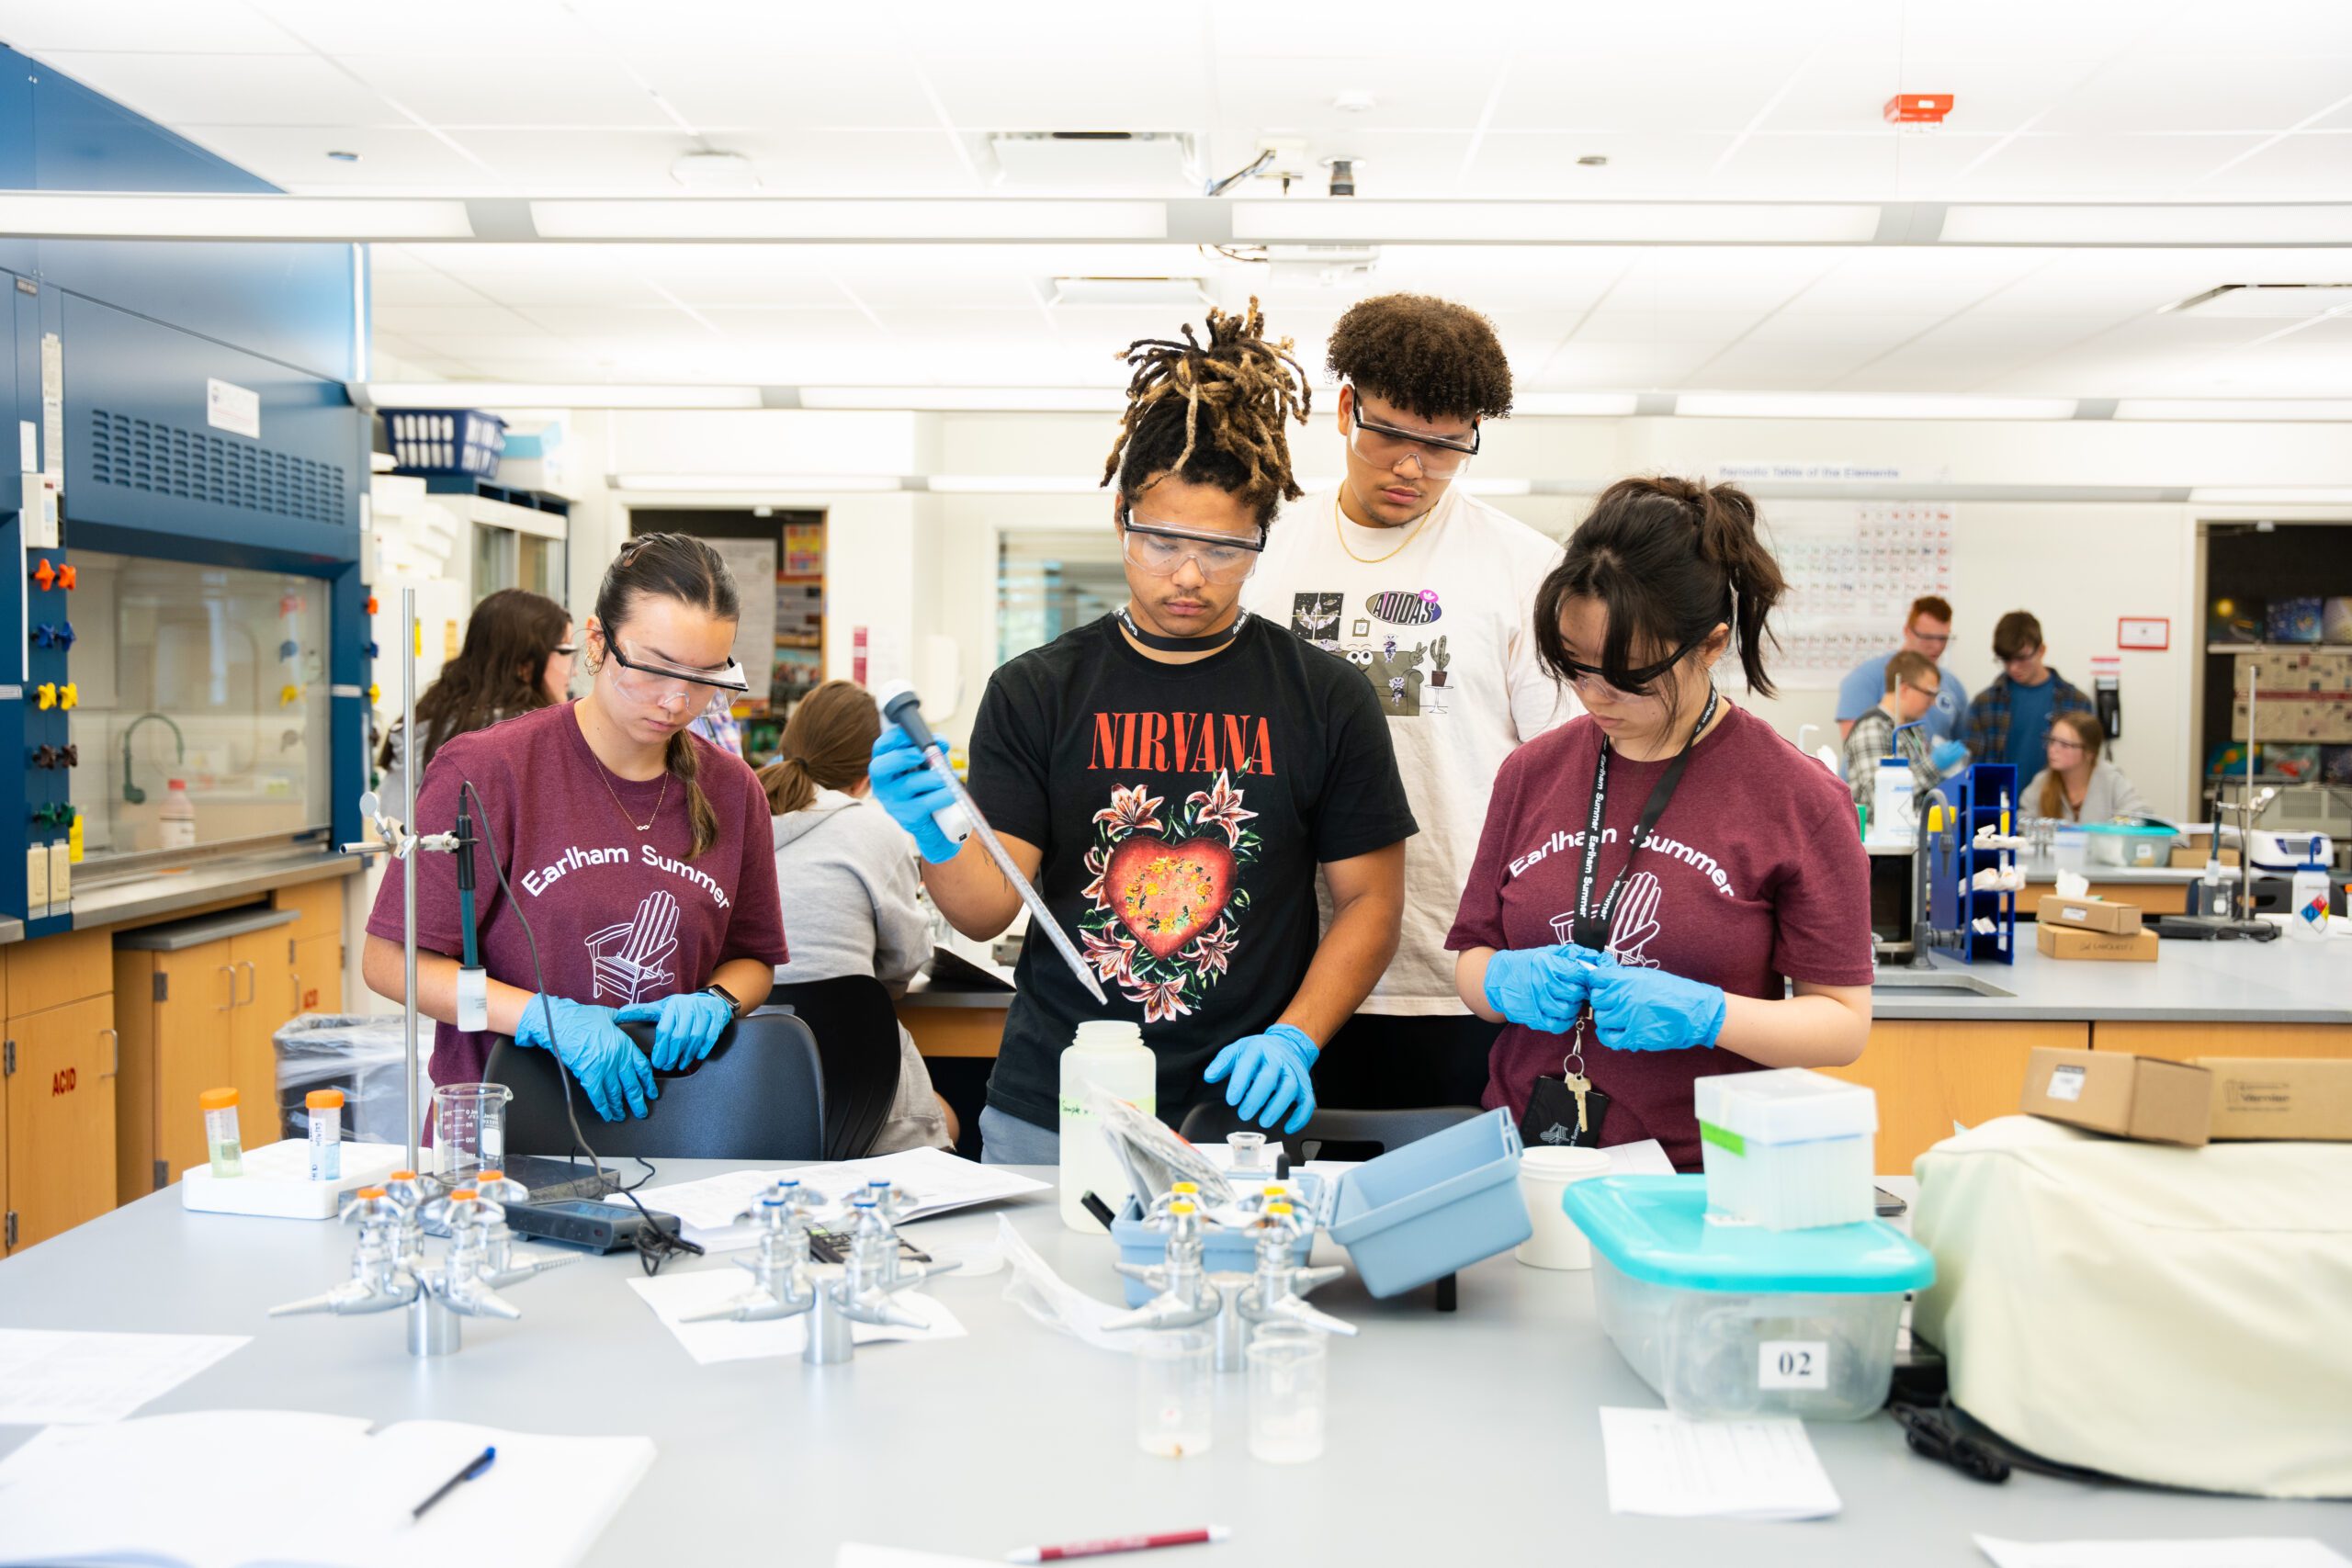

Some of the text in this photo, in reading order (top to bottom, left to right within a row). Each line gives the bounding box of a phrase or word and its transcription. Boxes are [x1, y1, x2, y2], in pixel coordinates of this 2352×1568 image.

[1720, 467, 1769, 478] Periodic
[1773, 466, 1803, 478] Table
[1823, 466, 1840, 478] the
[1373, 592, 1434, 625] ADIDAS
[1088, 712, 1275, 775] NIRVANA
[1579, 753, 1607, 918] Earlham Summer Earlham Summer
[521, 844, 730, 909] Earlham Summer
[1600, 879, 1621, 920] Summer
[52, 1067, 76, 1097] ACID
[1779, 1351, 1811, 1376] 02
